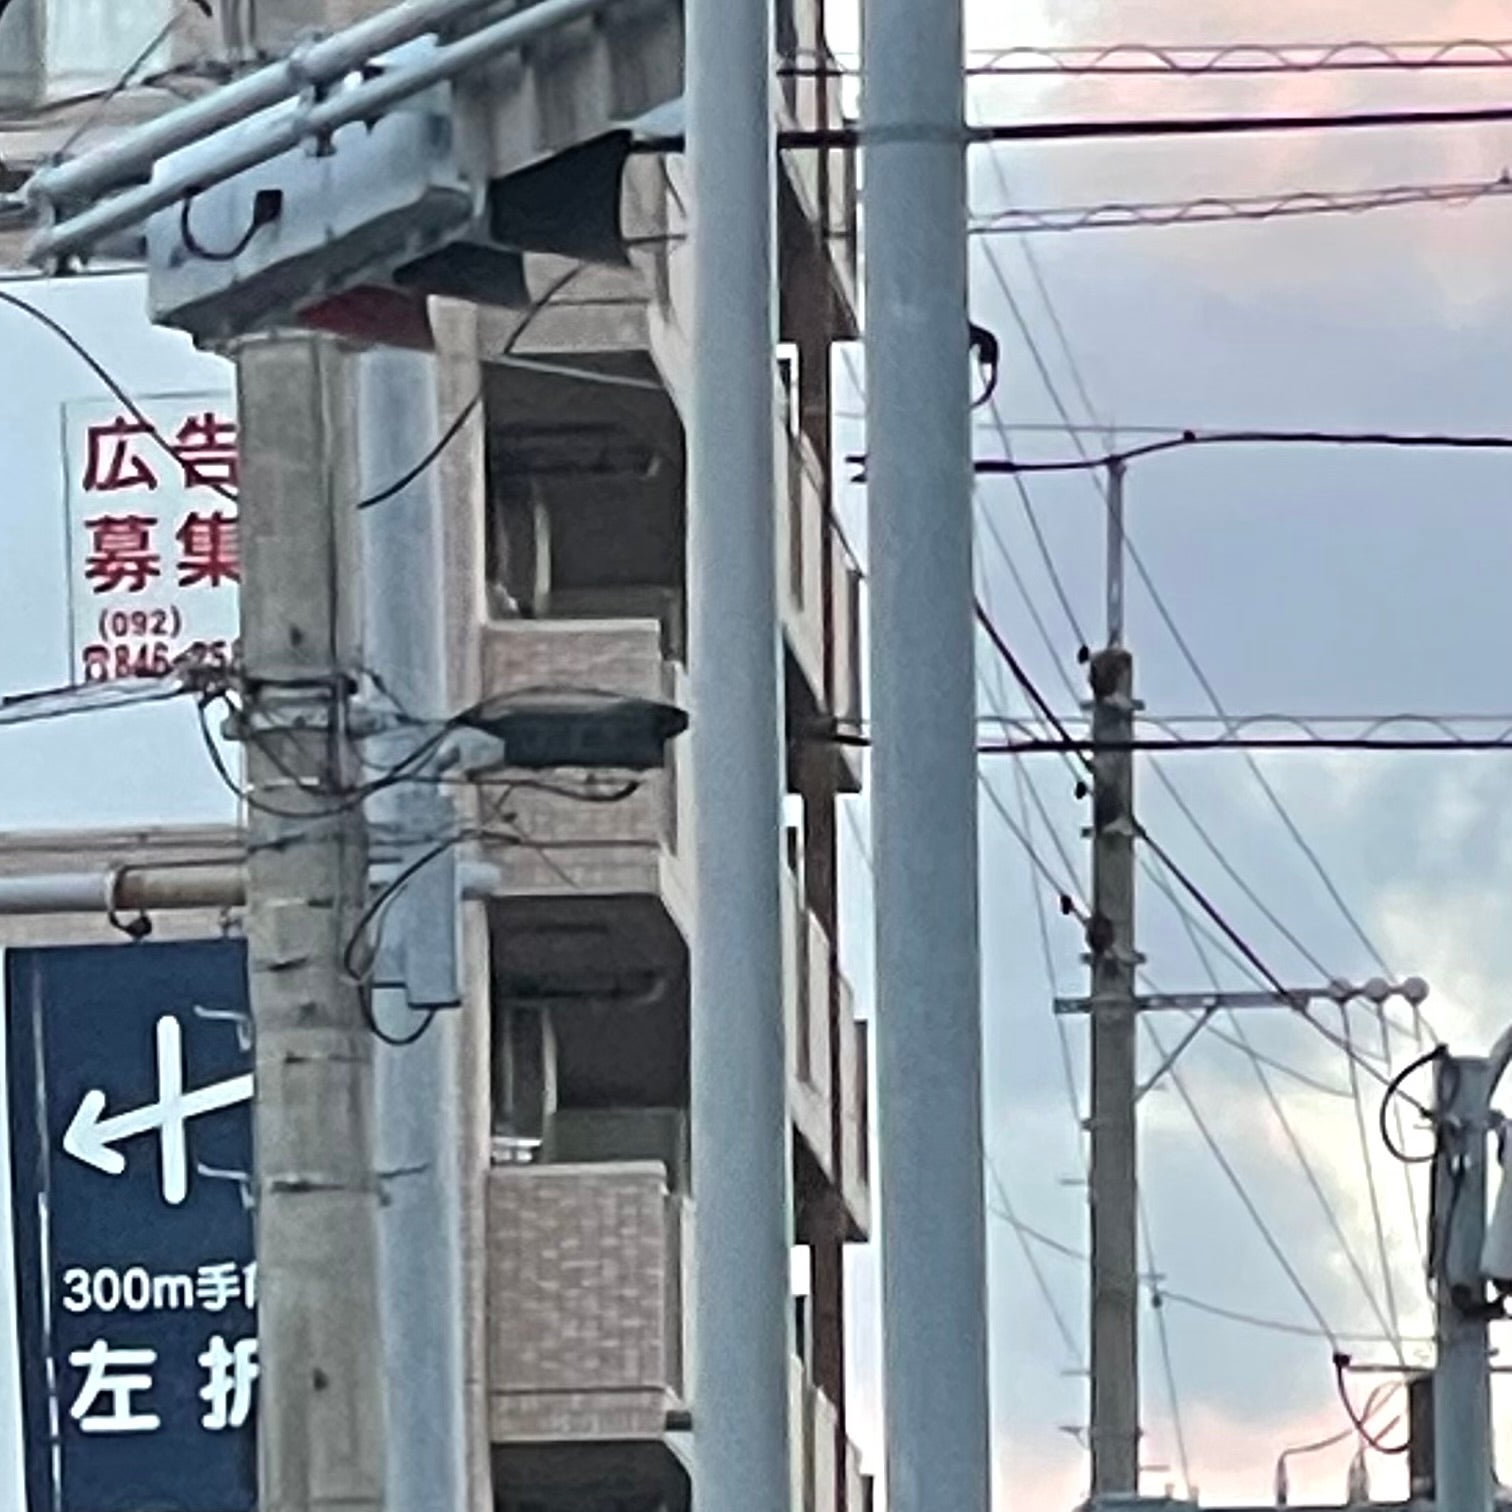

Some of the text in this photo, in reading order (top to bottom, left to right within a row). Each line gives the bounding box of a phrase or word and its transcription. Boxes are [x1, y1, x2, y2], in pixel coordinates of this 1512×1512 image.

[83, 412, 238, 491] 広告
[84, 511, 240, 593] 募集
[99, 605, 182, 641] (092)
